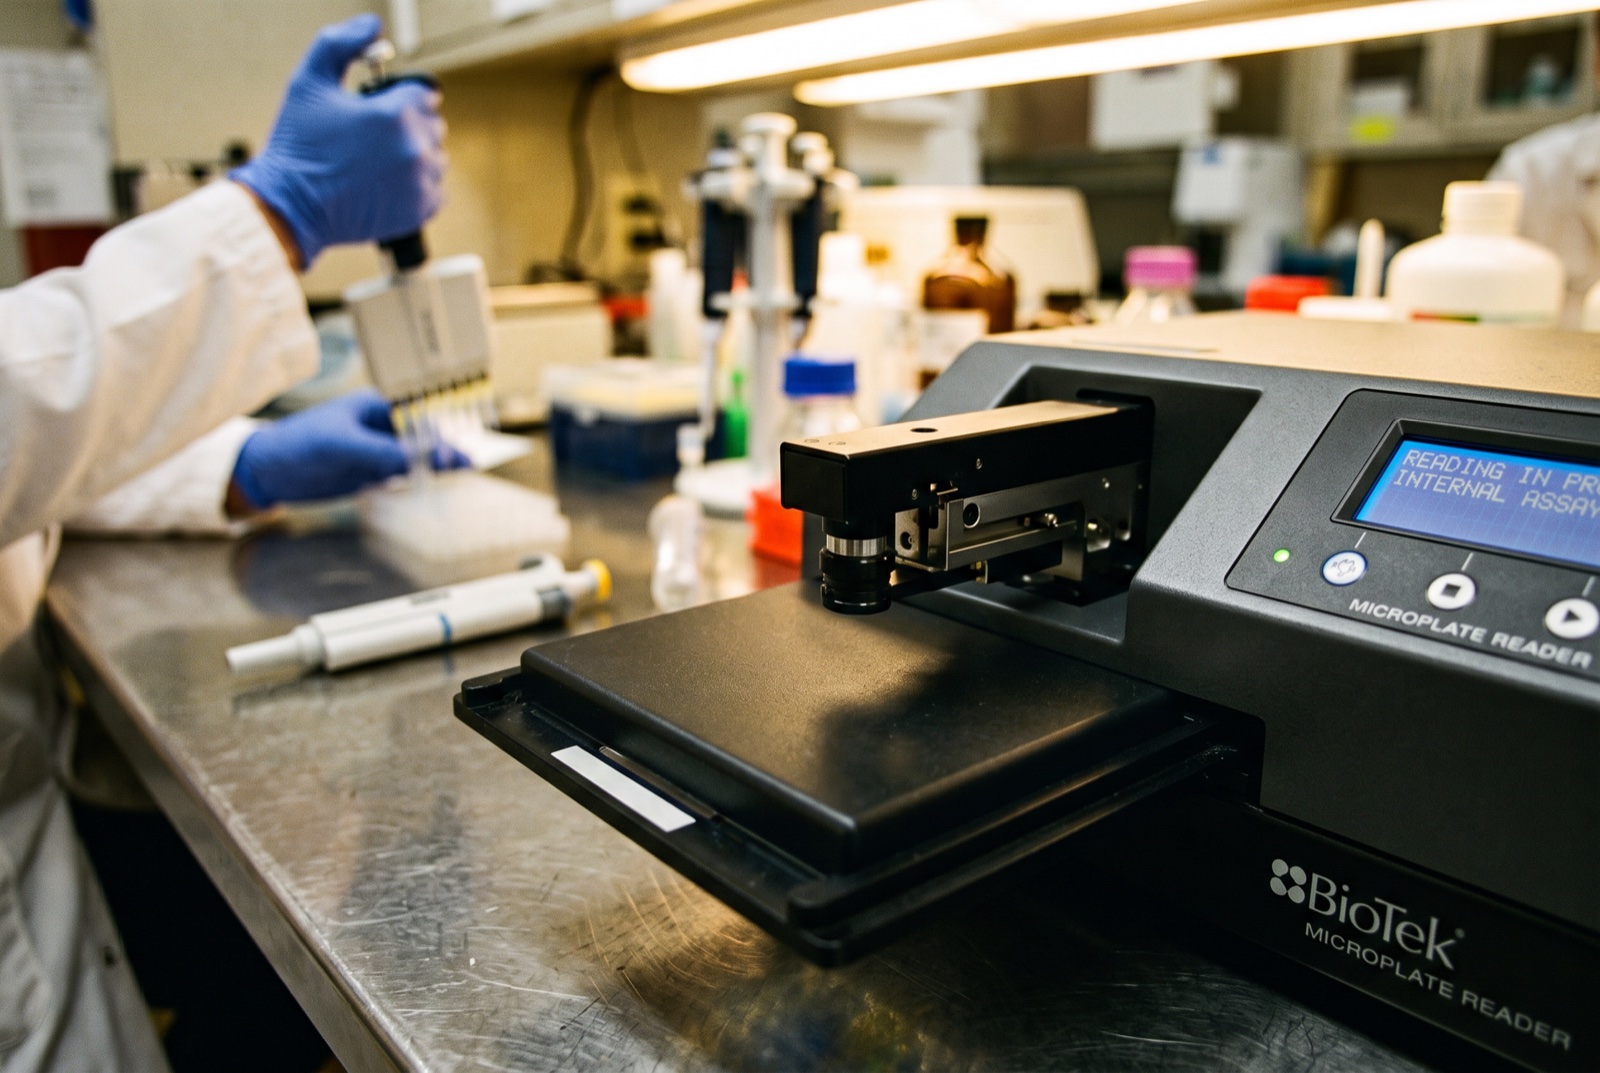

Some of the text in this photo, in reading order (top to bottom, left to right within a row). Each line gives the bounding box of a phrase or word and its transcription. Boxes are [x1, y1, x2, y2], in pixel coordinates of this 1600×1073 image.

[1393, 469, 1600, 518] INTERNAL ASSAY
[1402, 450, 1600, 496] READING IN PR
[1349, 598, 1593, 670] MICROPLATE READER
[1305, 922, 1572, 1051] MICROPLATE READER
